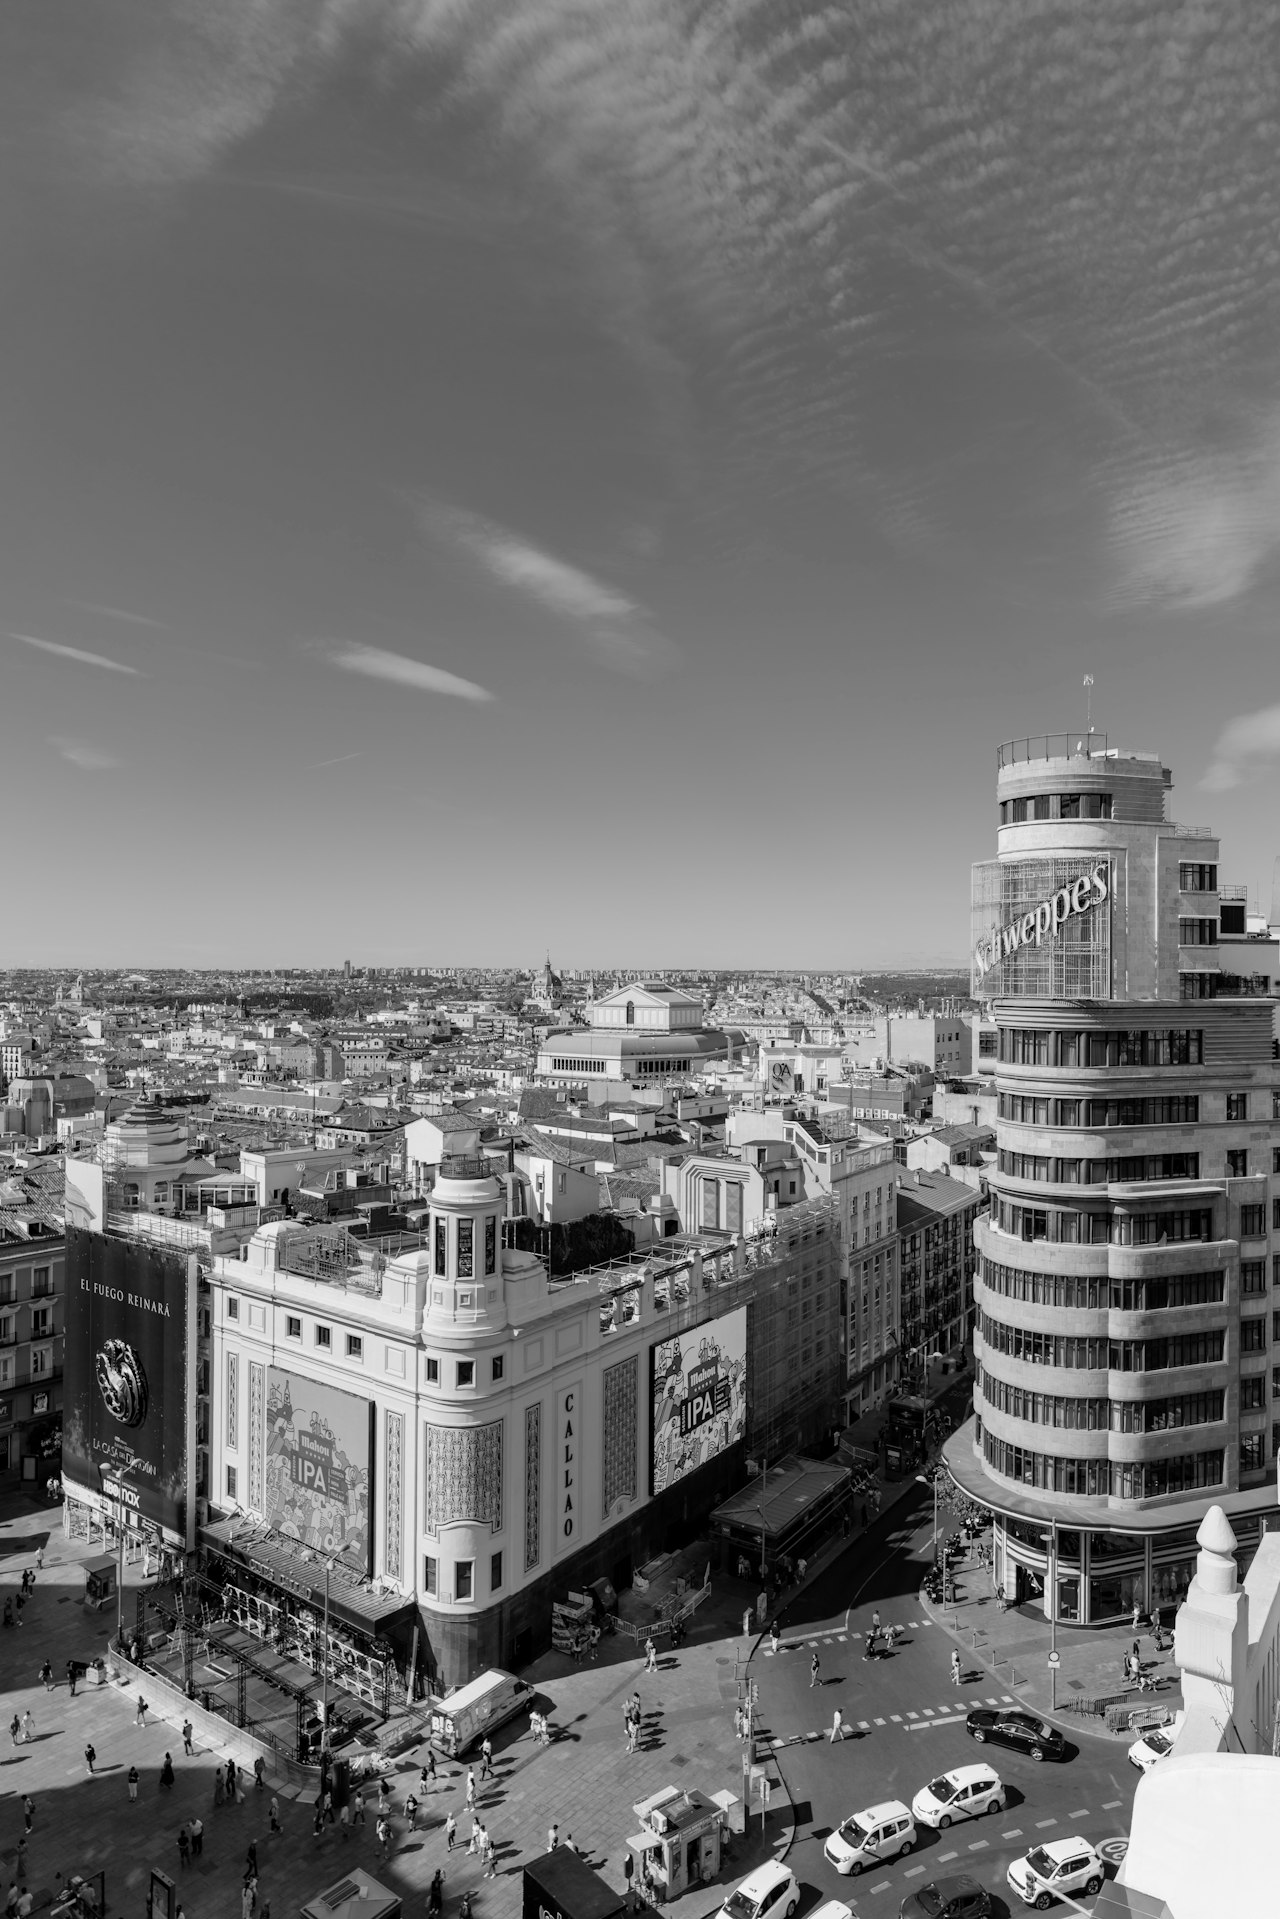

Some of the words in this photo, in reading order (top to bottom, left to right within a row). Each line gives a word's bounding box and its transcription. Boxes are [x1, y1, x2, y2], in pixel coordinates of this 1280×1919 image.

[975, 864, 1109, 986] Schweppes
[80, 1278, 90, 1292] EL
[93, 1282, 124, 1302] FUEGO
[127, 1293, 171, 1317] REINARÁ
[690, 1365, 716, 1388] Mahou
[687, 1391, 714, 1429] IPA
[301, 1435, 330, 1457] Mahou
[564, 1393, 574, 1537] CALLAO
[298, 1457, 327, 1493] IPA
